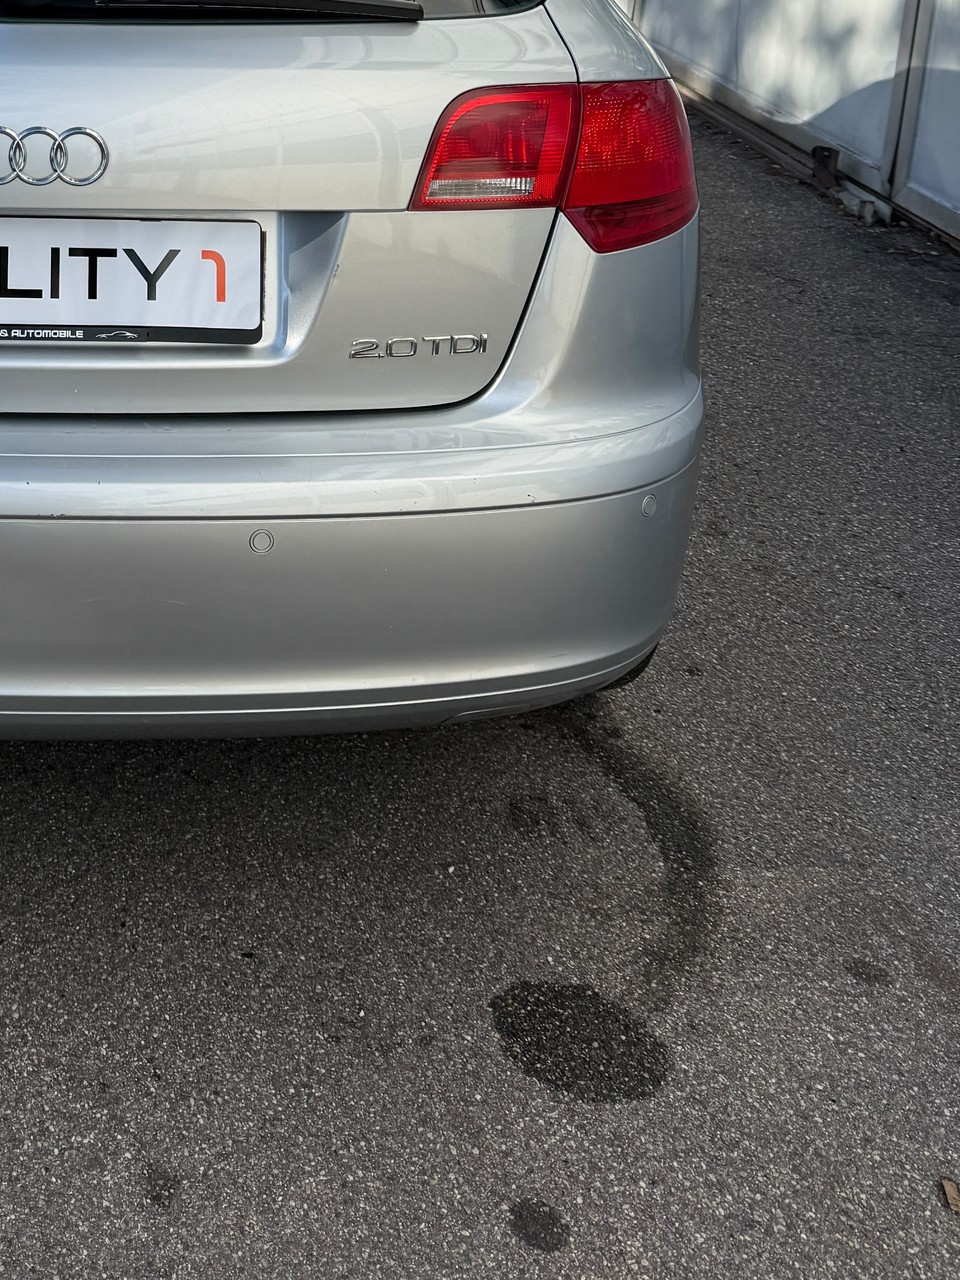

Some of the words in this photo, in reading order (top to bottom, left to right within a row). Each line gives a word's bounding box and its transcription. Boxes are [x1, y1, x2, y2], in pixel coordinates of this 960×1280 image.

[0, 329, 9, 337] &
[11, 329, 84, 338] AUTOMOBILE
[422, 333, 488, 356] TDI
